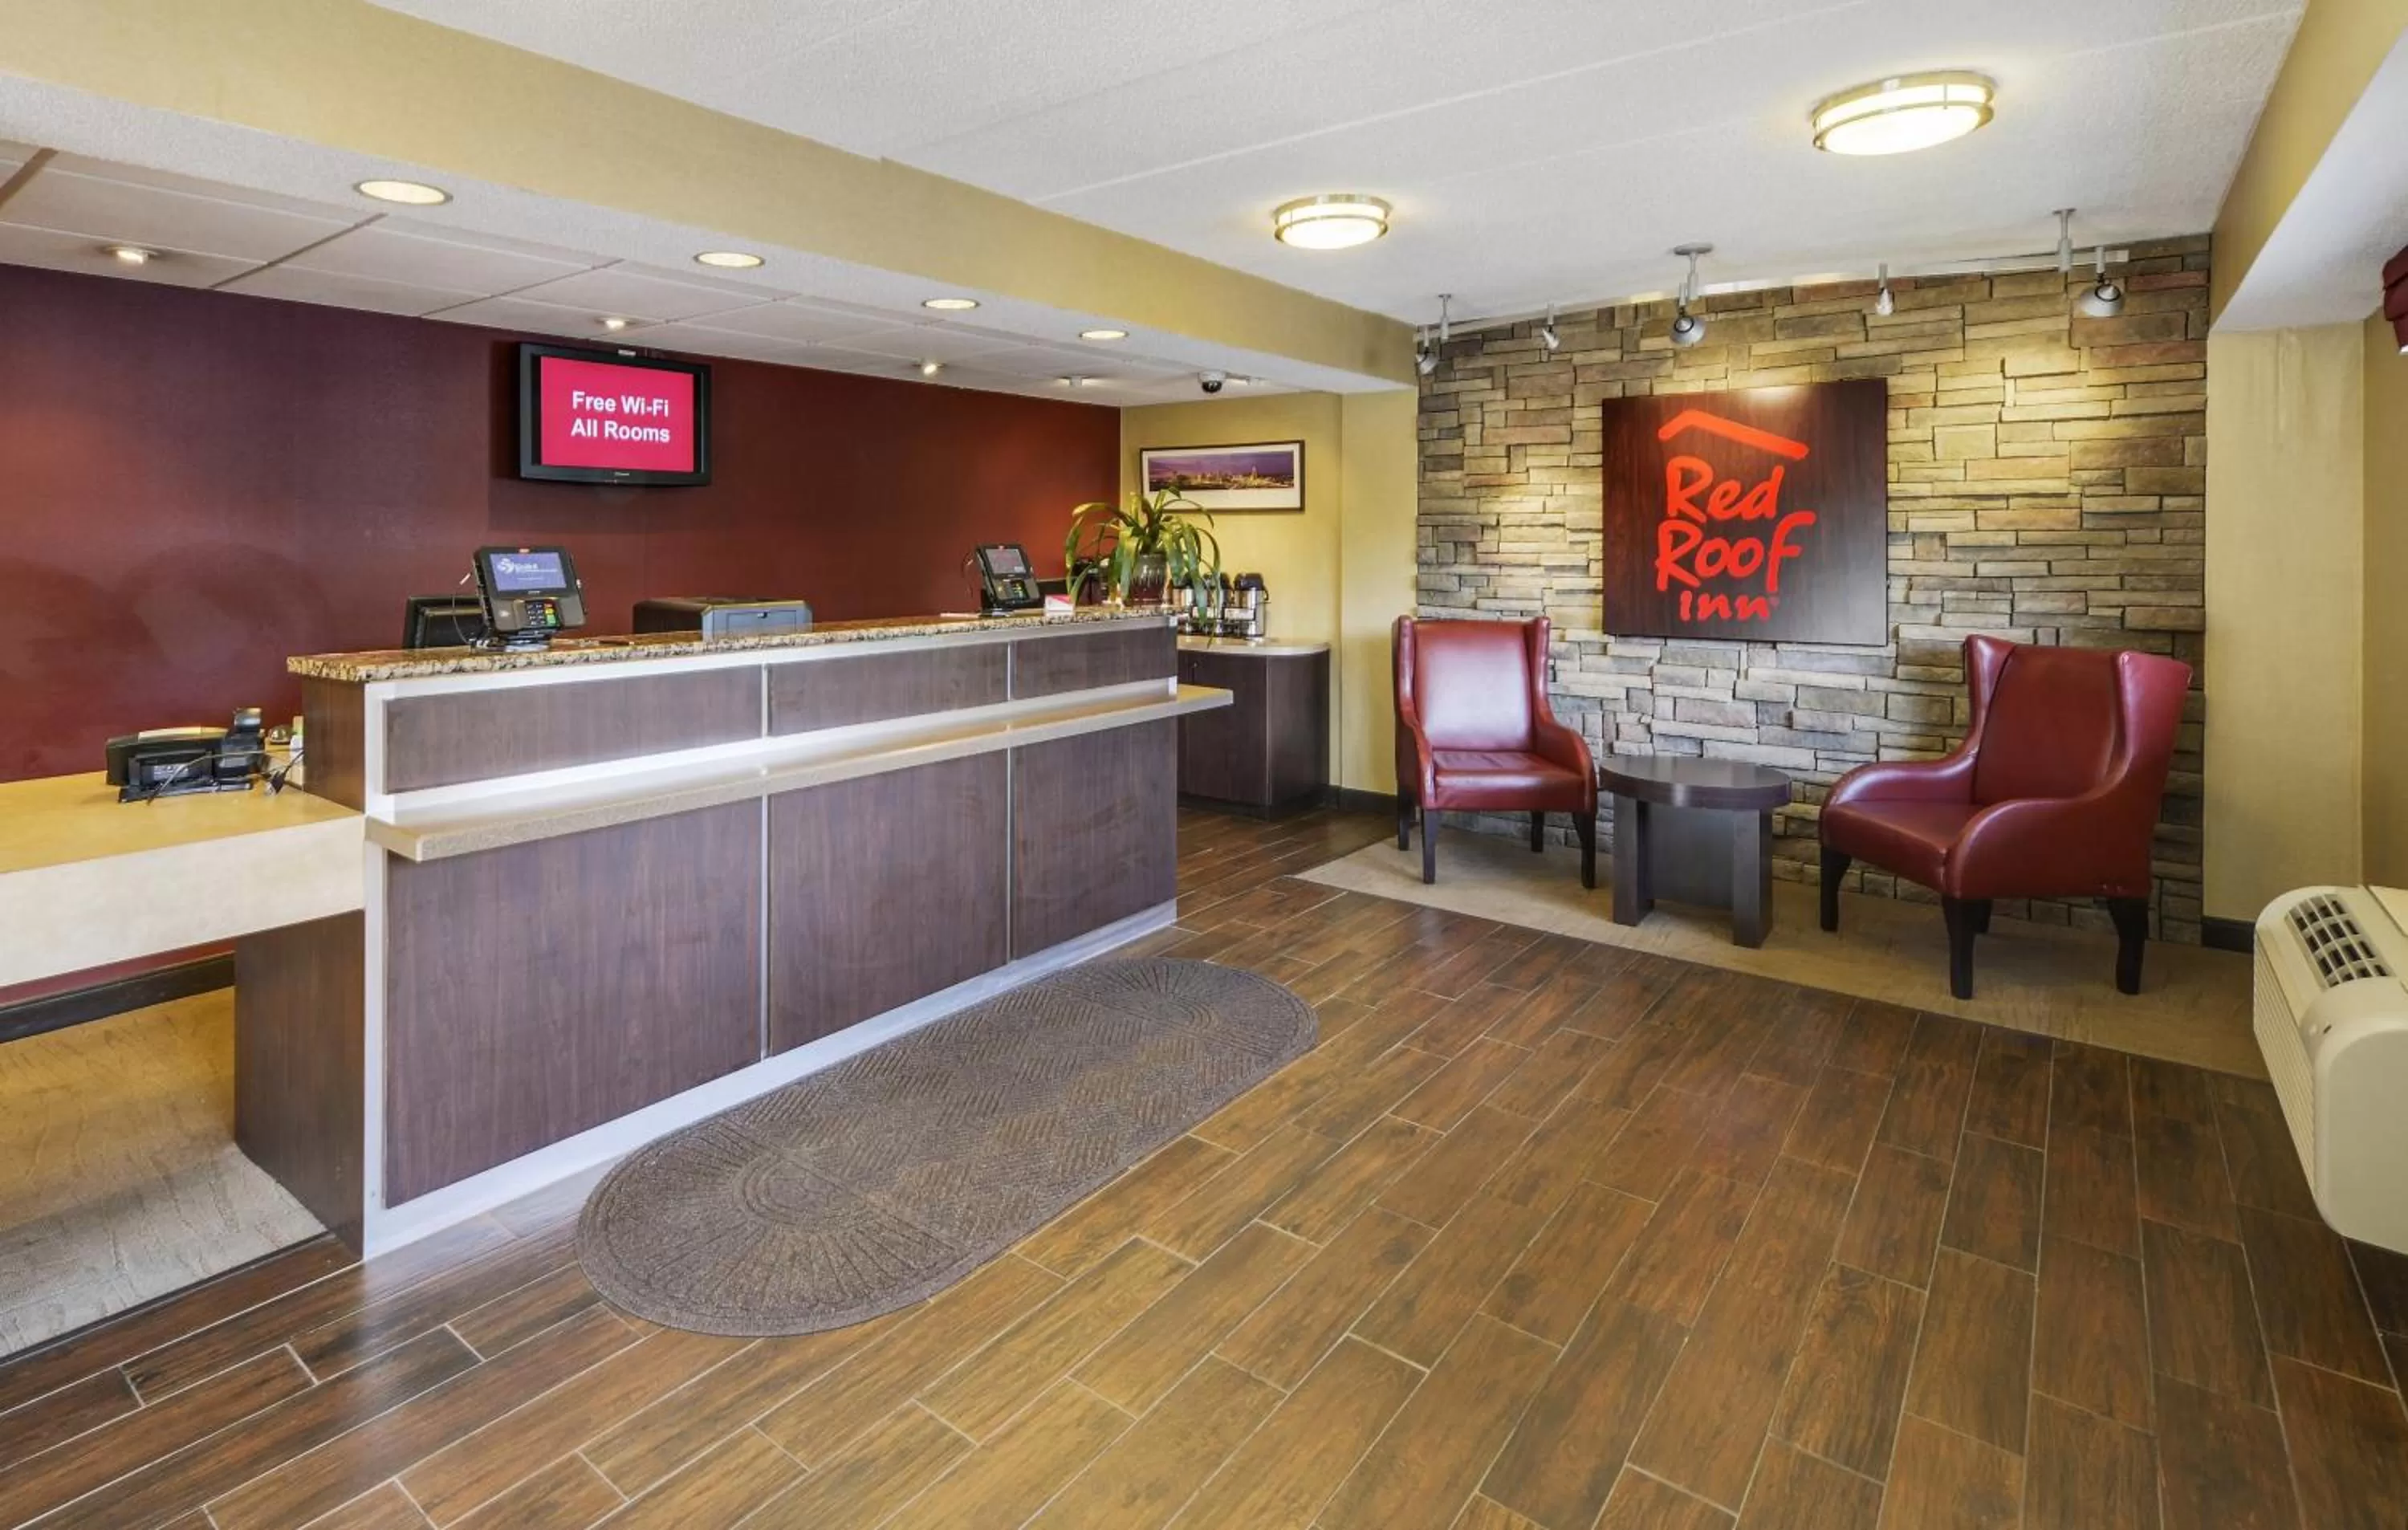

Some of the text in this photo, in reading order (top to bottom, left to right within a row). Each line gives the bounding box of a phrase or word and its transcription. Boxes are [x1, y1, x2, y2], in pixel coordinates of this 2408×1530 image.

[571, 390, 669, 417] Free Wi-Fi
[570, 418, 671, 442] All Rooms
[1665, 454, 1785, 523] Red
[1655, 511, 1816, 592] Roof
